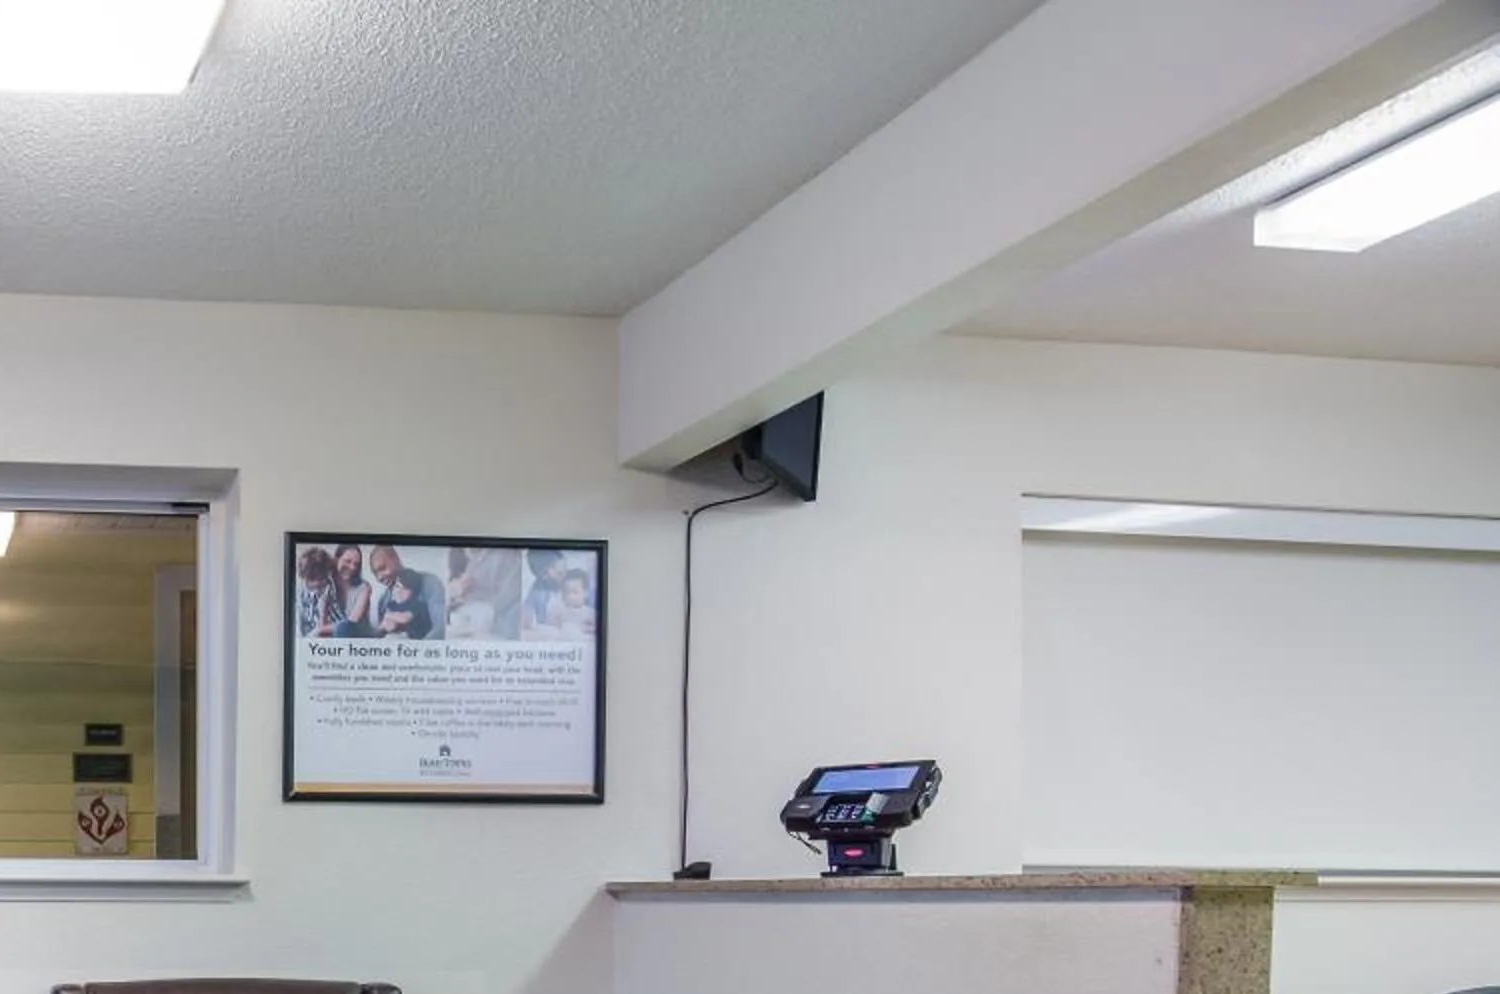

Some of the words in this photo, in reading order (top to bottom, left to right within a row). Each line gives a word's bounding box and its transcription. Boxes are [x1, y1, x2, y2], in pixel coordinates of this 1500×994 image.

[308, 643, 344, 657] Your
[349, 644, 392, 657] home
[397, 643, 419, 658] for
[424, 648, 441, 659] as
[445, 645, 479, 663] long
[484, 649, 501, 659] as
[505, 649, 533, 664] you
